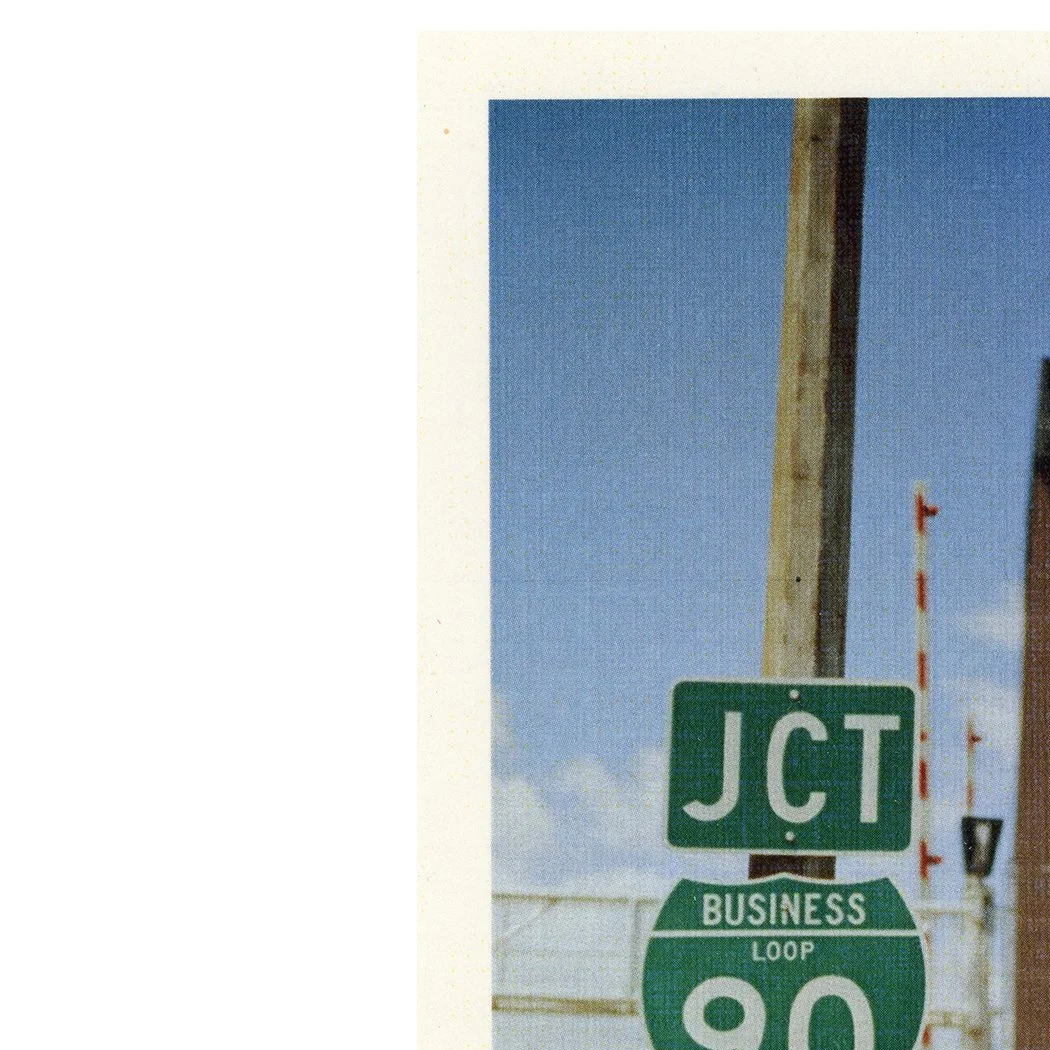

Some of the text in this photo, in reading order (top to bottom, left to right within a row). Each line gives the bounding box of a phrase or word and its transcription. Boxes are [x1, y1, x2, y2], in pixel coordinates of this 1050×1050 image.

[683, 711, 900, 824] JCT
[703, 893, 866, 926] BUSINESS
[752, 941, 814, 961] LOOP
